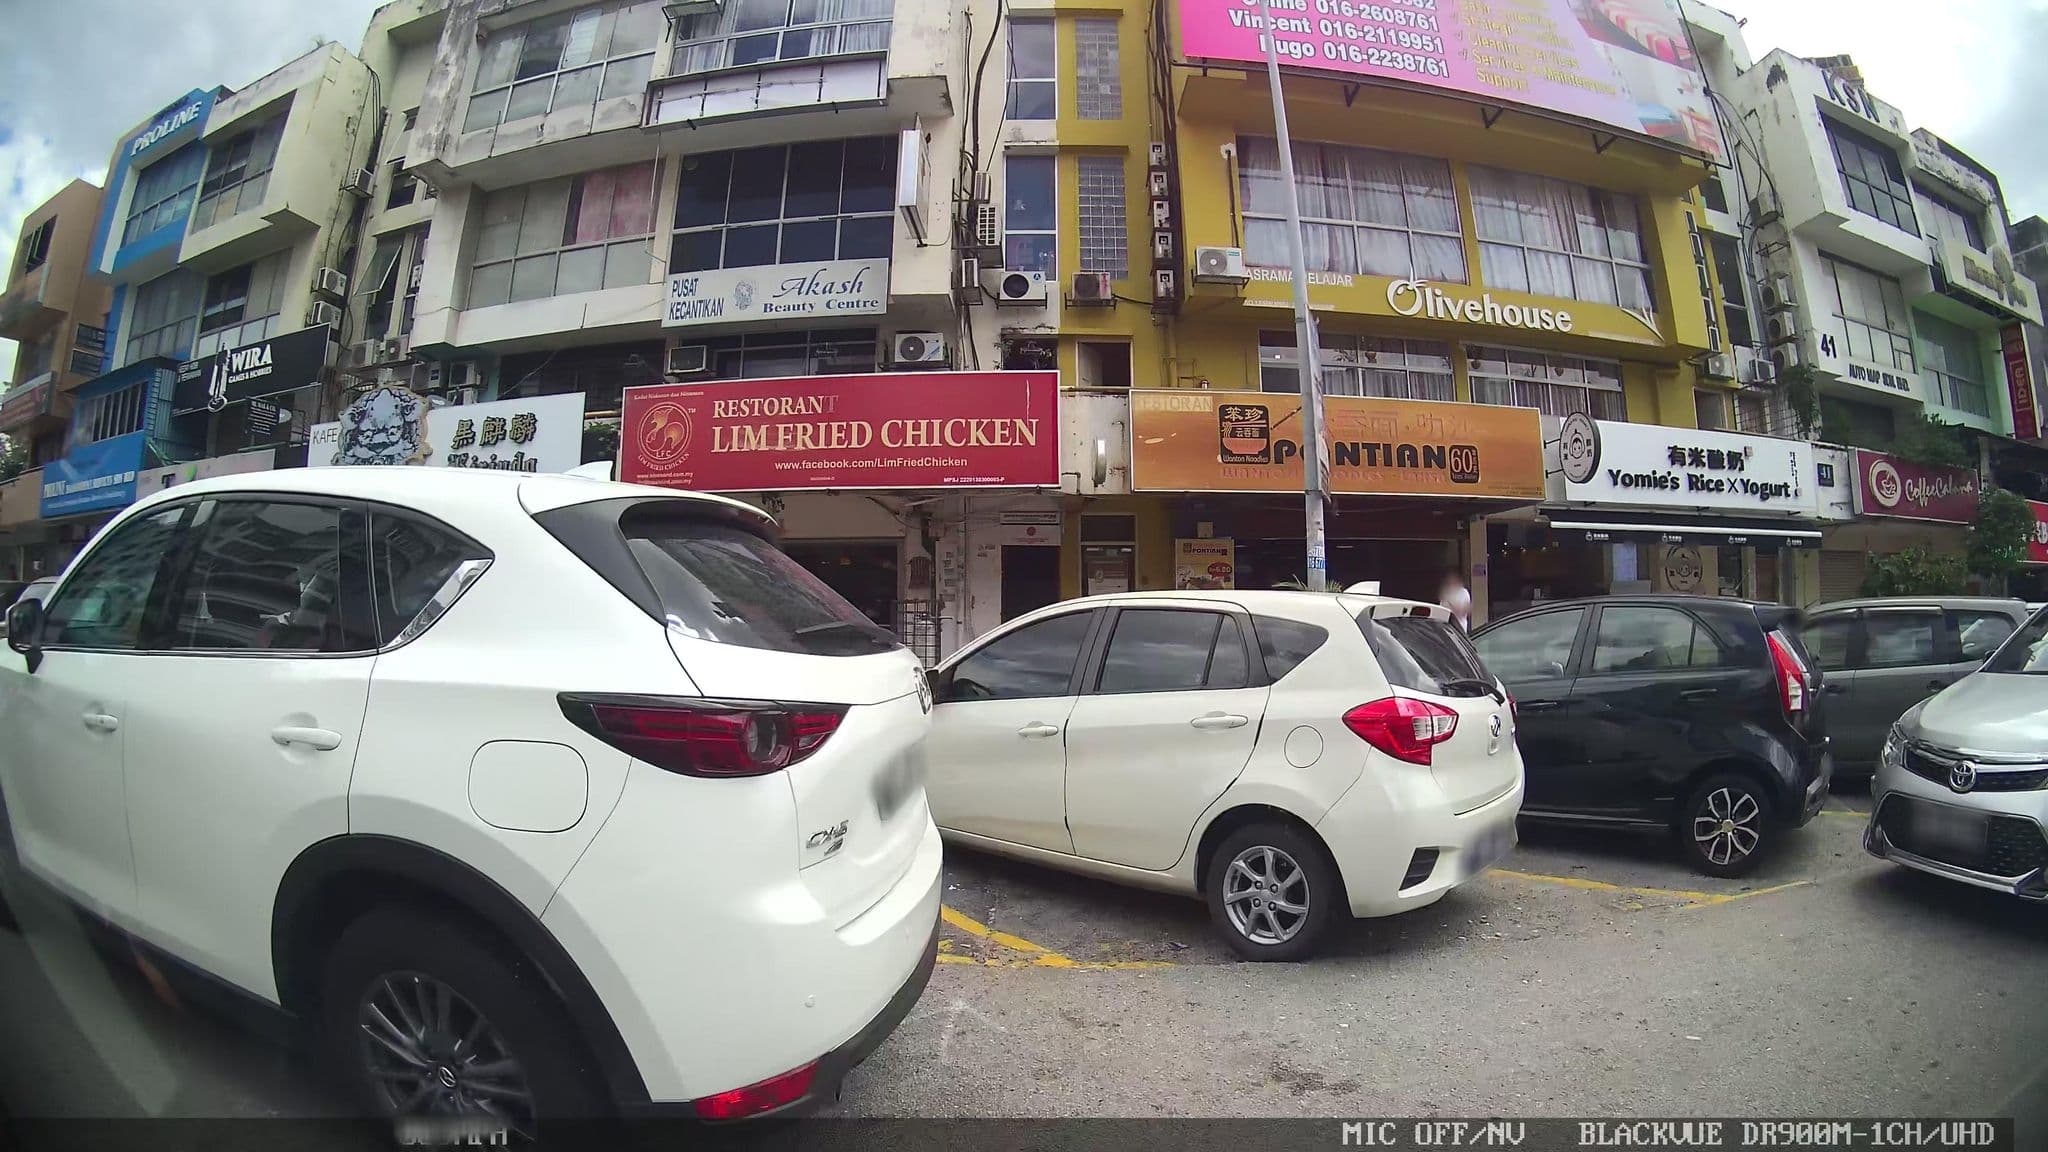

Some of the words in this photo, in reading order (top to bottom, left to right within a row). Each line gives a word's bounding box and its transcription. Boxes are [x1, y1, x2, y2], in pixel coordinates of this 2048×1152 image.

[1228, 9, 1313, 34] Vincent
[1318, 18, 1445, 54] 016-2119951
[1315, 0, 1440, 32] 016-2608761
[1322, 41, 1450, 78] 016-2238761
[130, 101, 202, 157] PROLINE
[671, 277, 699, 298] PUSAT
[772, 266, 871, 298] Akash
[668, 297, 724, 321] KECANTIKAN
[762, 301, 817, 314] Beauty
[825, 298, 879, 310] Centre
[1386, 278, 1574, 333] Olivehouse
[231, 343, 273, 373] WIRA
[1820, 333, 1837, 359] 41
[1223, 406, 1265, 421] 笨珍
[312, 427, 338, 445] KAFE
[711, 423, 770, 453] LIM
[775, 420, 873, 451] FRIED
[880, 418, 1039, 448] CHICKEN
[774, 456, 968, 470] www.facebook.com/LimFriedChicken
[1273, 438, 1447, 470] PNTIAN
[1450, 447, 1473, 473] 60
[1607, 469, 1680, 491] Yomie's
[1686, 473, 1725, 493] Rice
[1739, 478, 1791, 501] Yogurt
